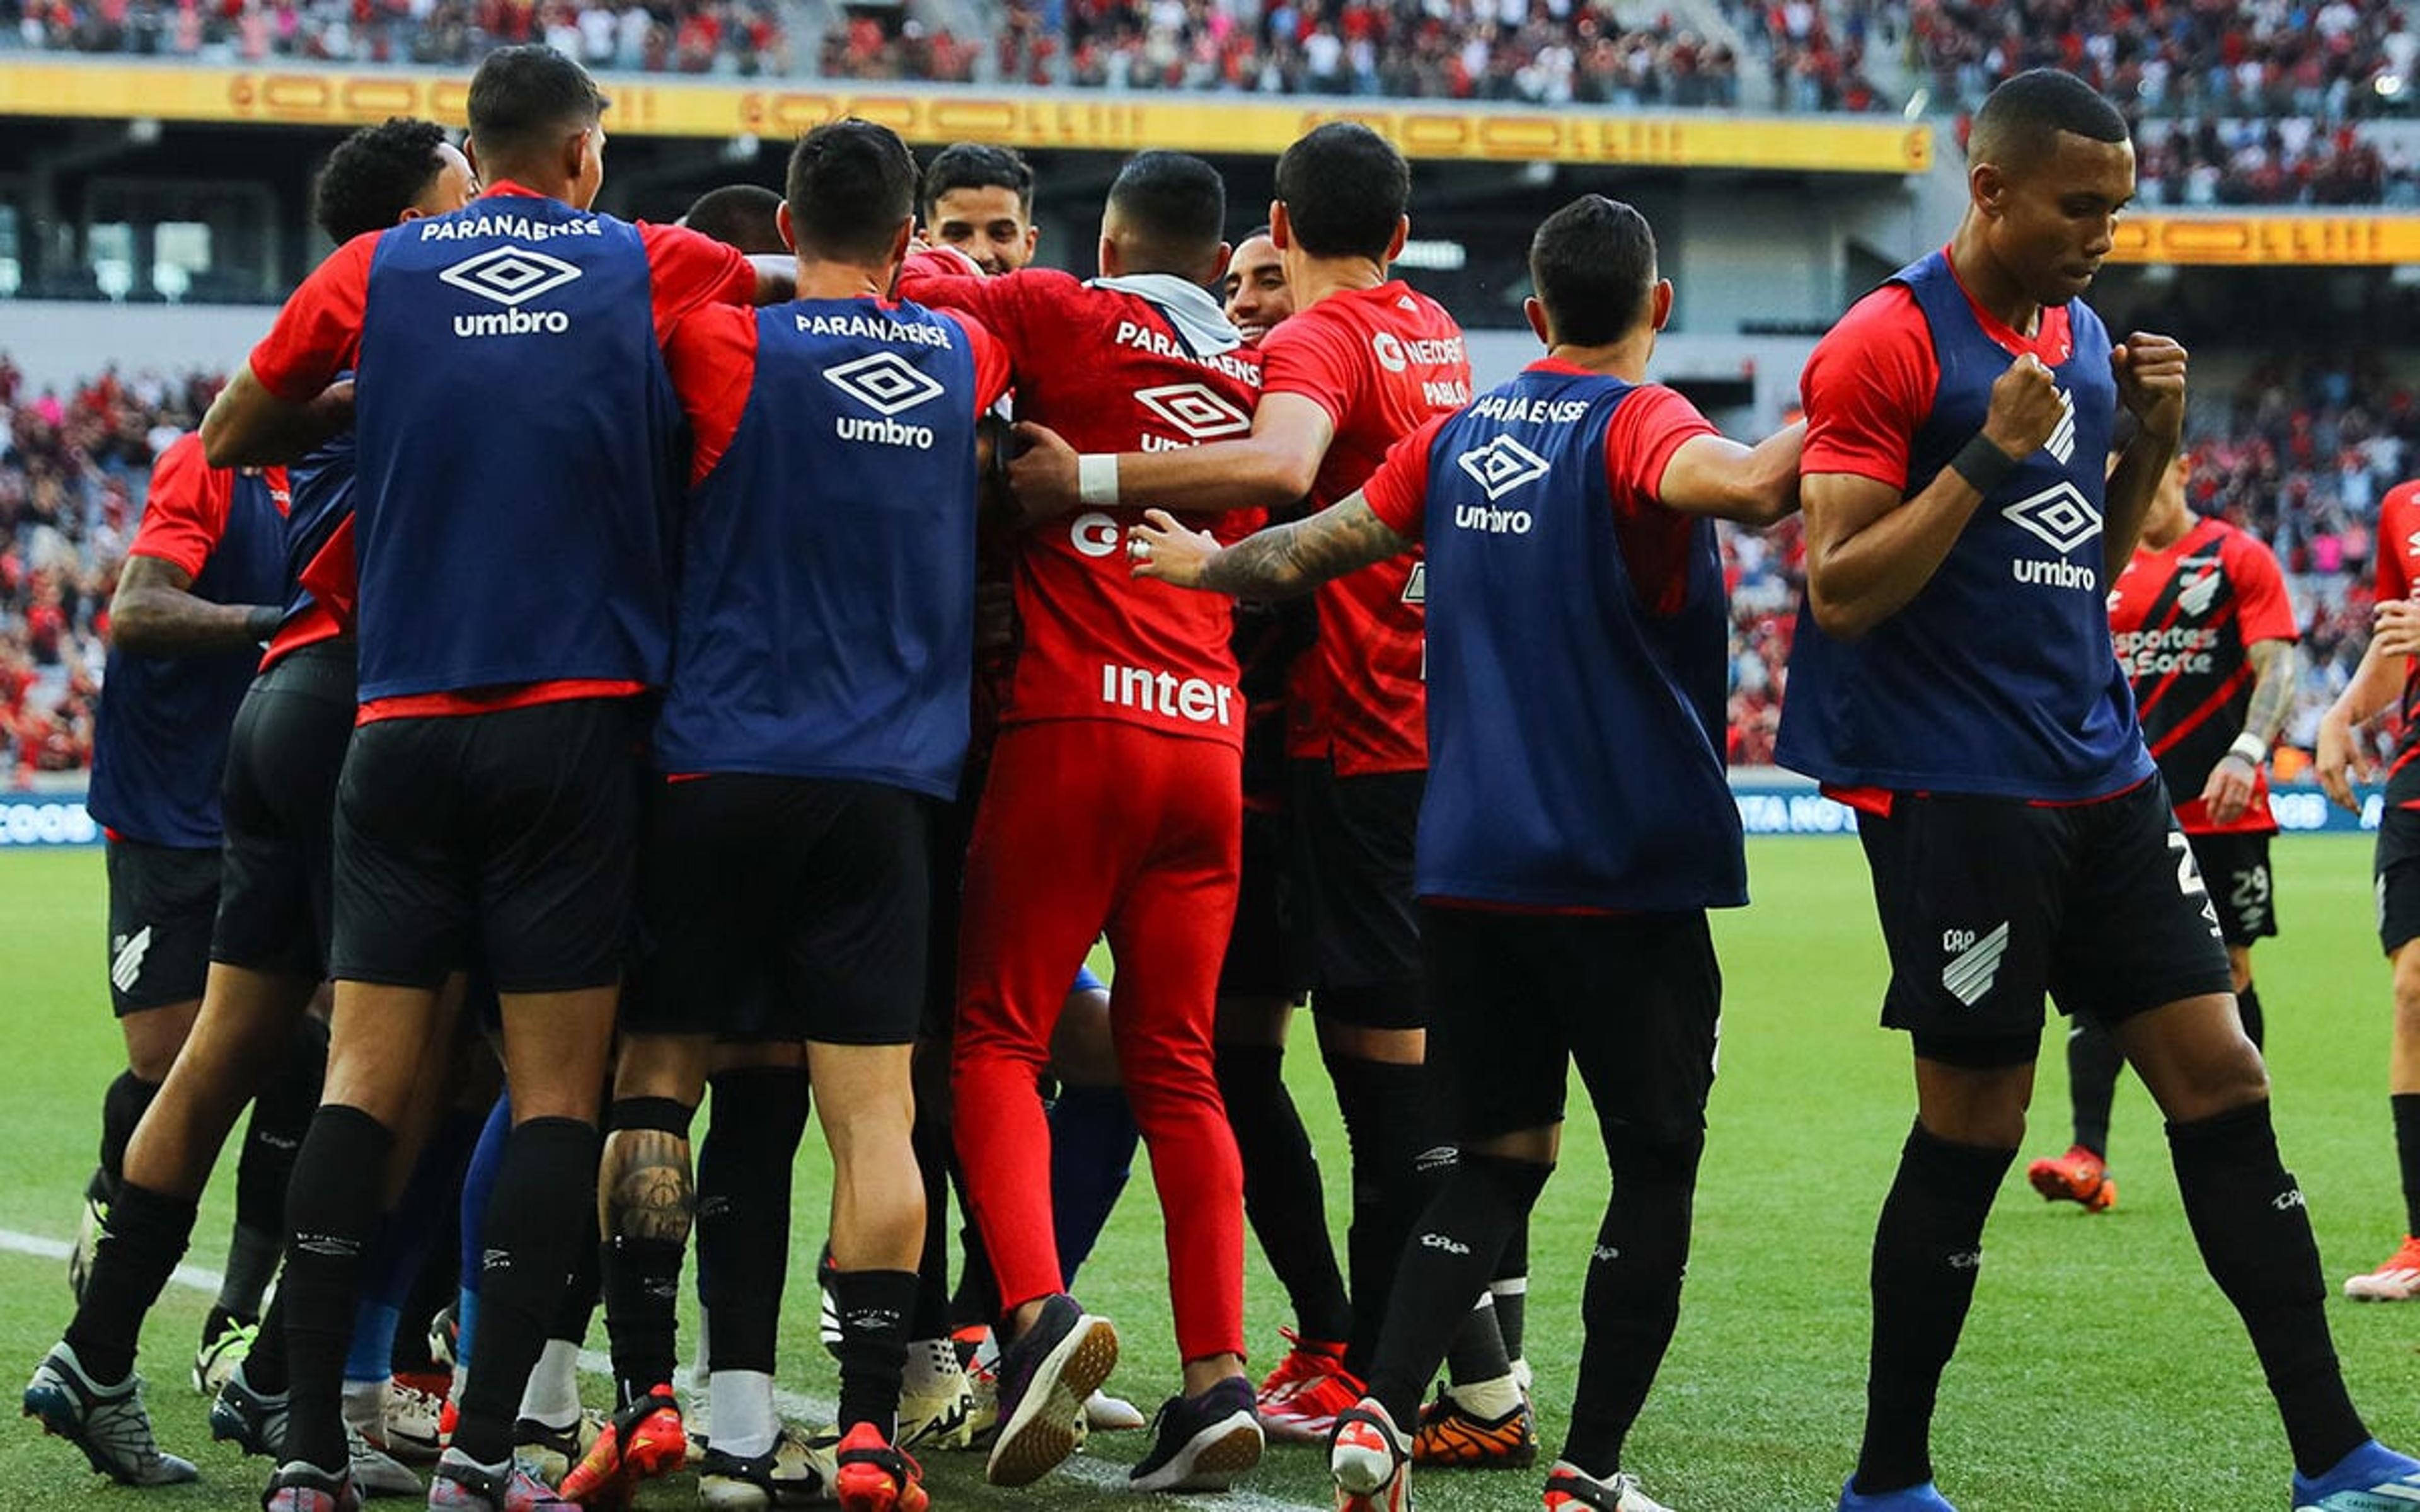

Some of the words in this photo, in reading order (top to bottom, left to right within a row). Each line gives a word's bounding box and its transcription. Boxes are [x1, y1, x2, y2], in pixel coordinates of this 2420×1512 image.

[421, 215, 602, 241] PARANAENSE
[453, 307, 569, 337] umbro
[836, 417, 934, 450] umbro
[1455, 505, 1532, 534] umbro
[2013, 557, 2095, 592] umbro
[2231, 865, 2269, 907] 29
